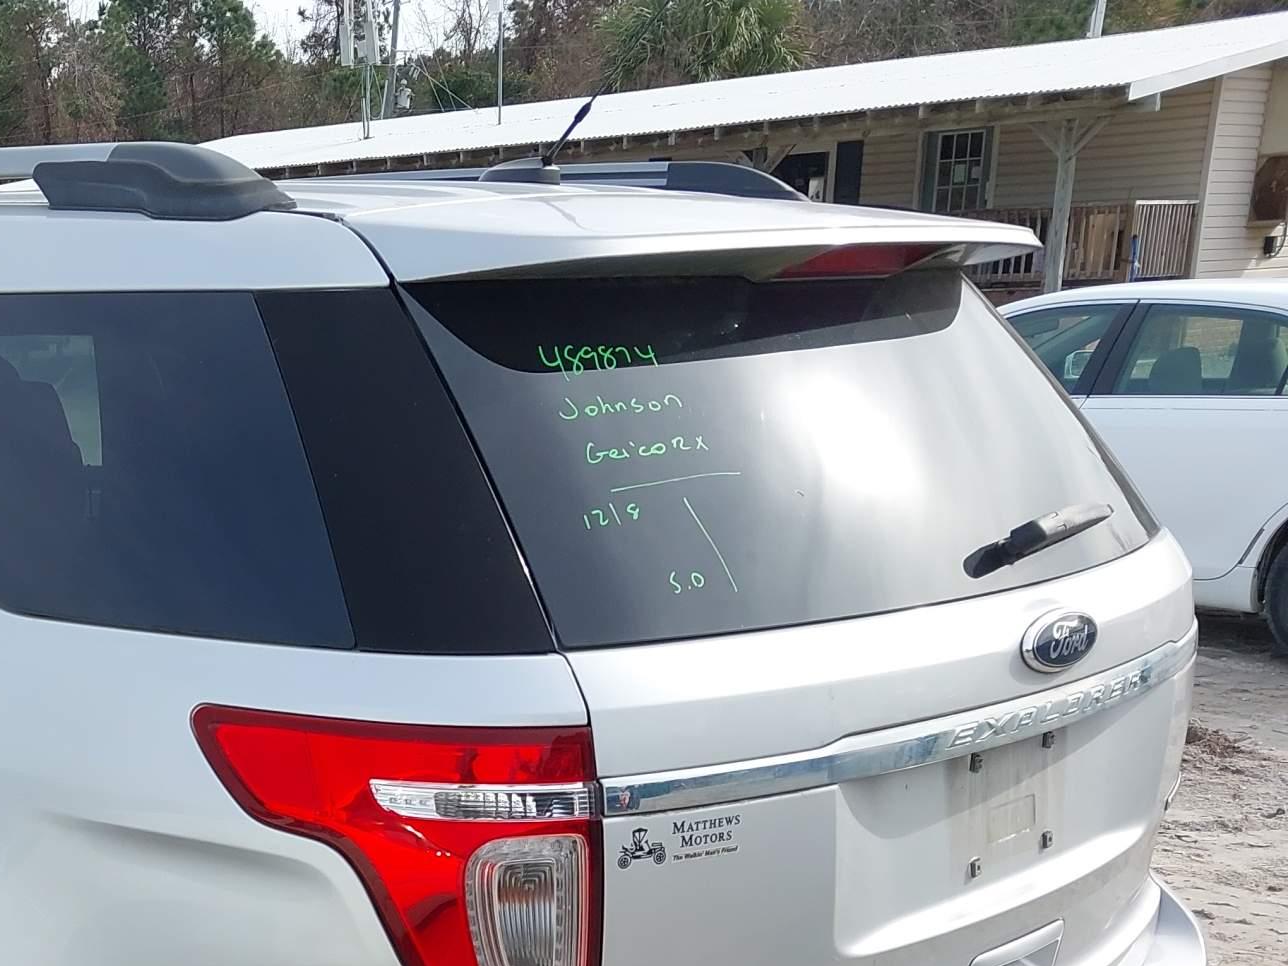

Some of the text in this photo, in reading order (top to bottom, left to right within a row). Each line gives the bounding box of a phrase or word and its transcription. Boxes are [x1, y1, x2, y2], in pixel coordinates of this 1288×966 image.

[558, 393, 683, 420] Johnson
[586, 441, 666, 464] Geico
[1049, 619, 1089, 659] Ford
[946, 667, 1150, 751] EXPLORER
[671, 814, 741, 835] MATTHEWS
[679, 830, 733, 848] MOTORS
